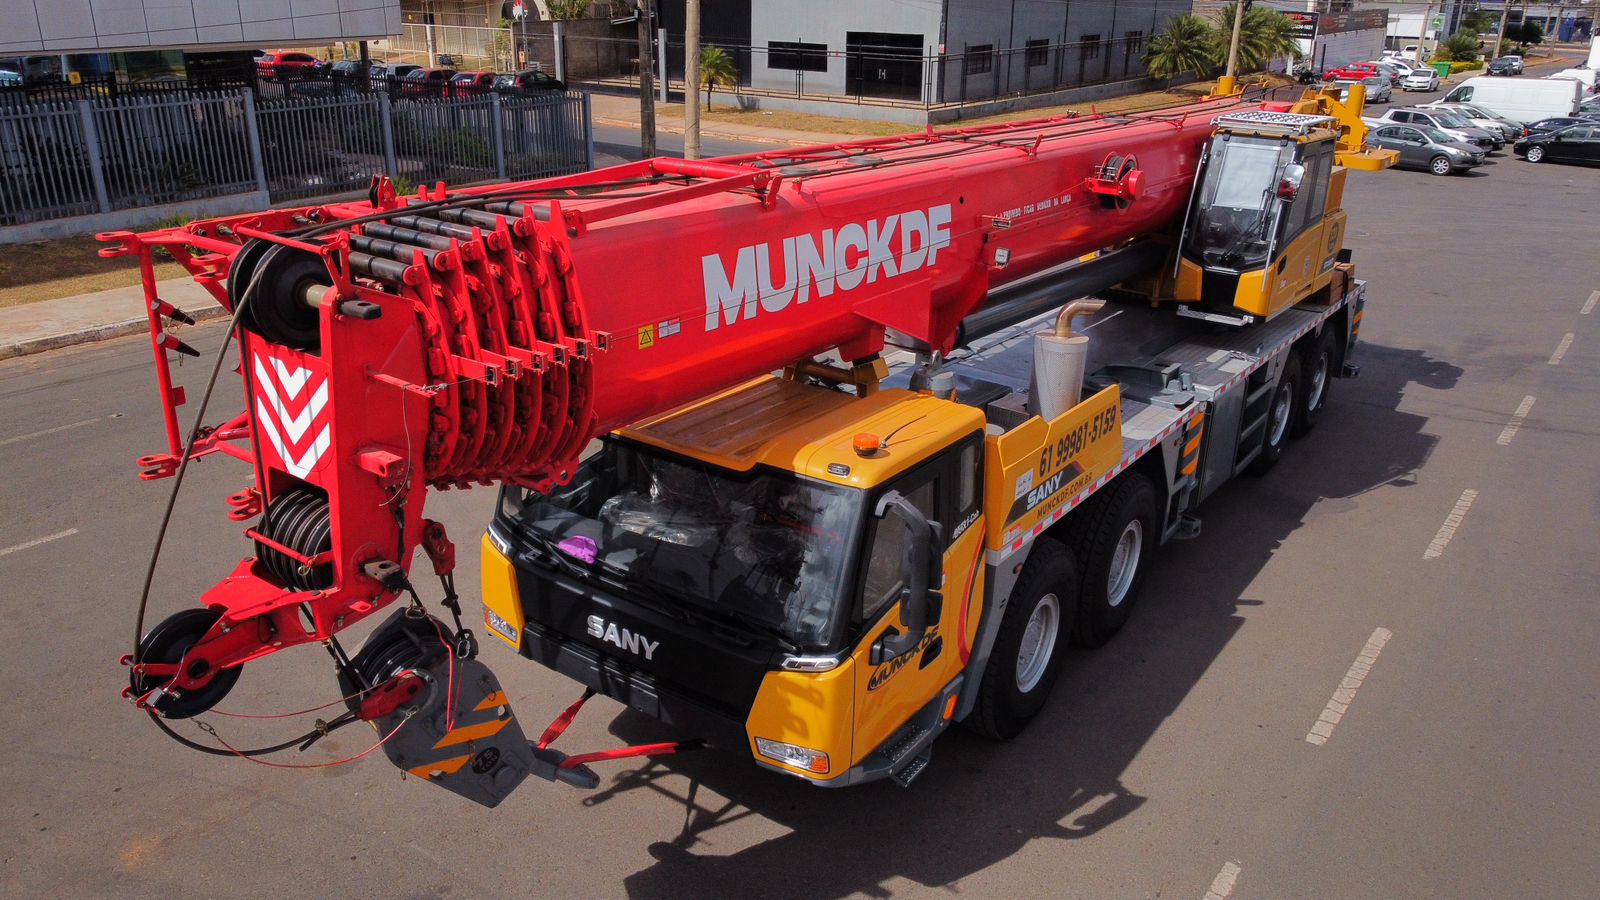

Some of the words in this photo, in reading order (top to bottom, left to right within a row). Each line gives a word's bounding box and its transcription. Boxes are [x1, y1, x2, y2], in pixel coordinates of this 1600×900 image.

[702, 203, 951, 332] MUNCKDF
[1040, 445, 1053, 477] 61
[1055, 405, 1117, 467] 99981-5159
[1027, 472, 1062, 510] SANY
[1036, 472, 1093, 519] MUNCKDF.COM.BR
[587, 615, 659, 660] SANY
